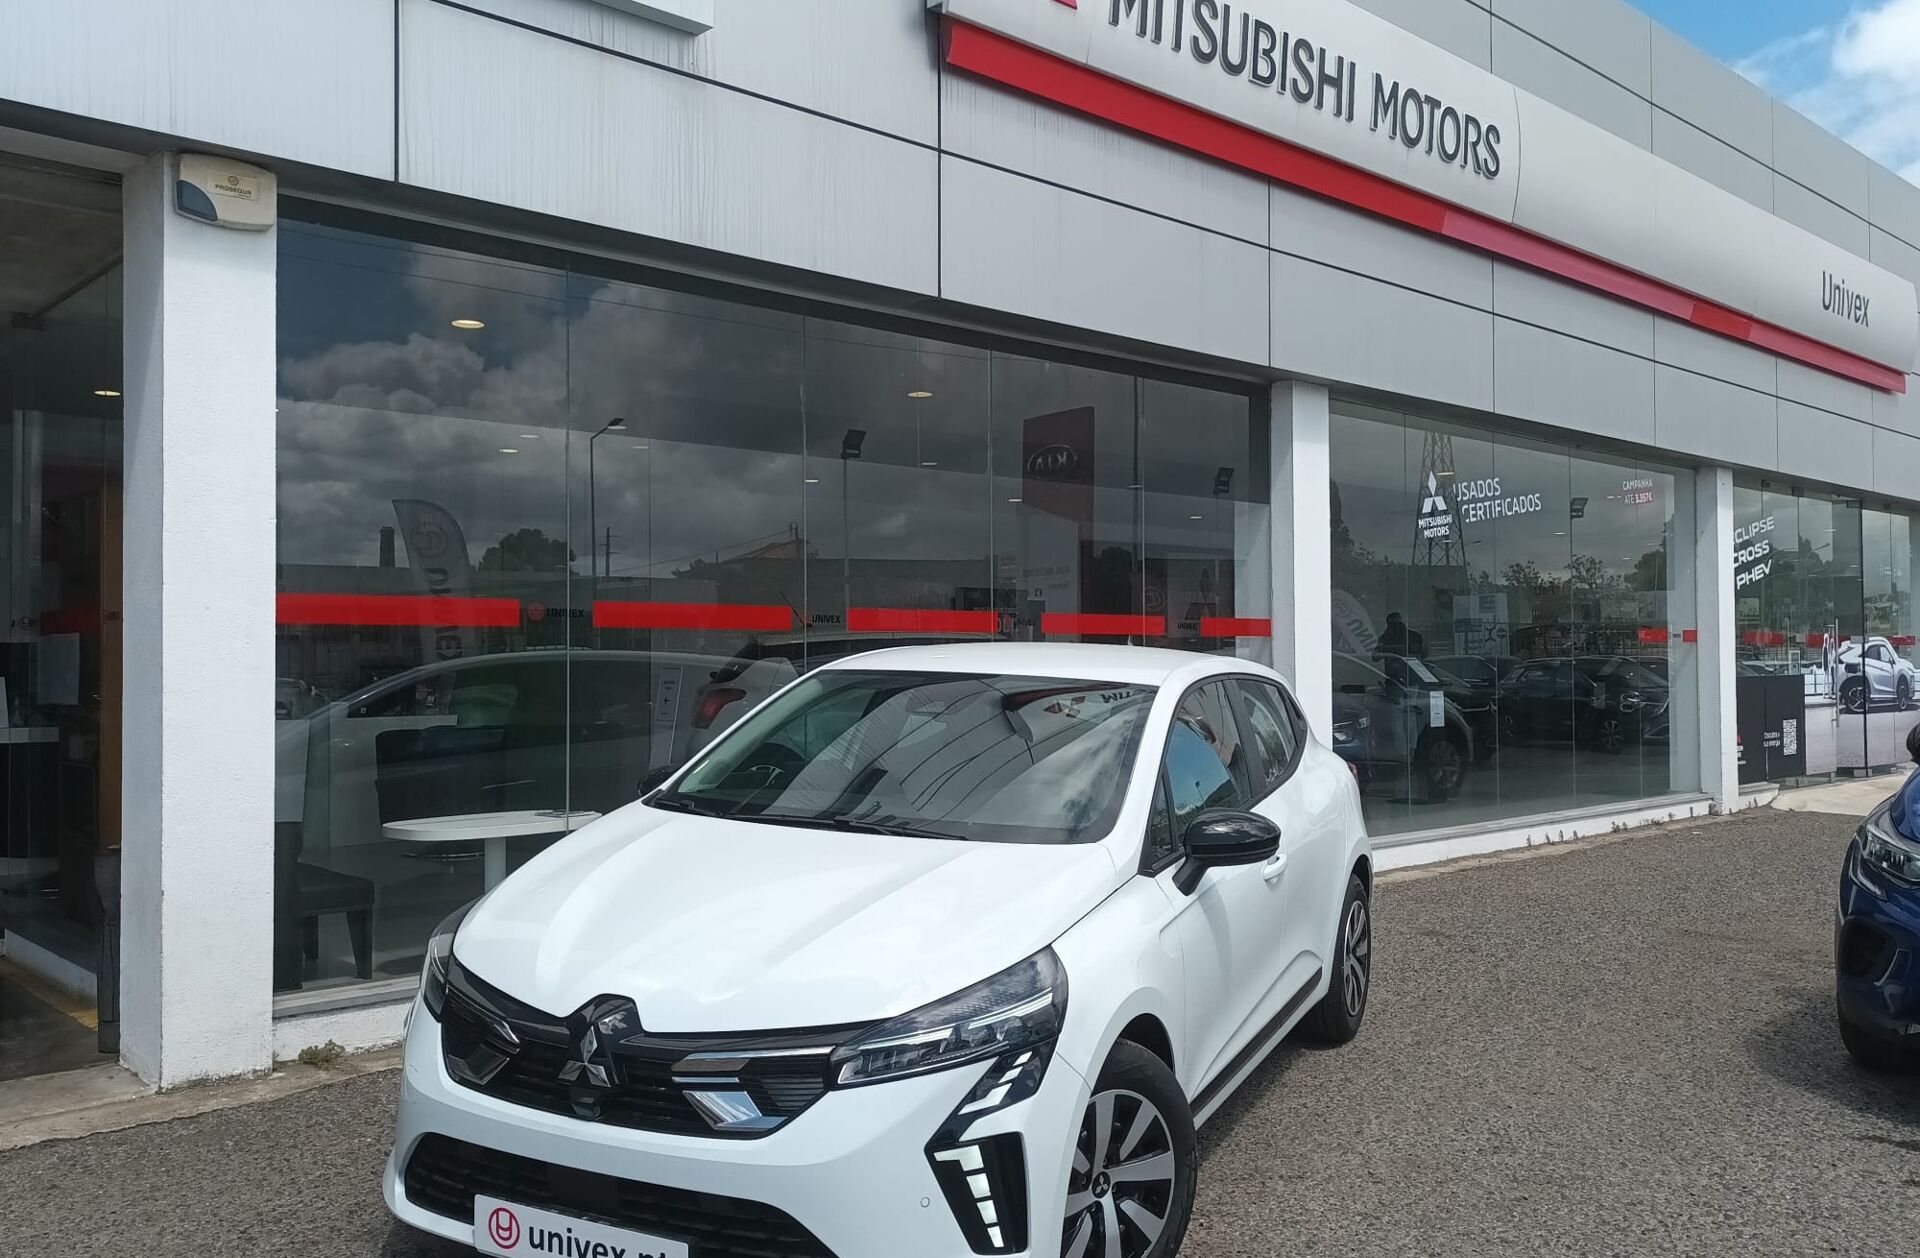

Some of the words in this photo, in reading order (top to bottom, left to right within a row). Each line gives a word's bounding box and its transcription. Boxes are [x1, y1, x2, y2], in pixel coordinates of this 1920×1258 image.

[1370, 71, 1501, 180] MOTORS
[1822, 270, 1870, 328] Univex
[1453, 477, 1501, 502] USADOS
[1418, 513, 1453, 529] MITSUBISHI
[1461, 493, 1542, 523] CERTIFICADOS
[1423, 525, 1450, 538] MOTORS
[1733, 515, 1775, 544] CLIPSE
[1736, 559, 1772, 591] PHEV
[812, 613, 841, 624] UNIVEX
